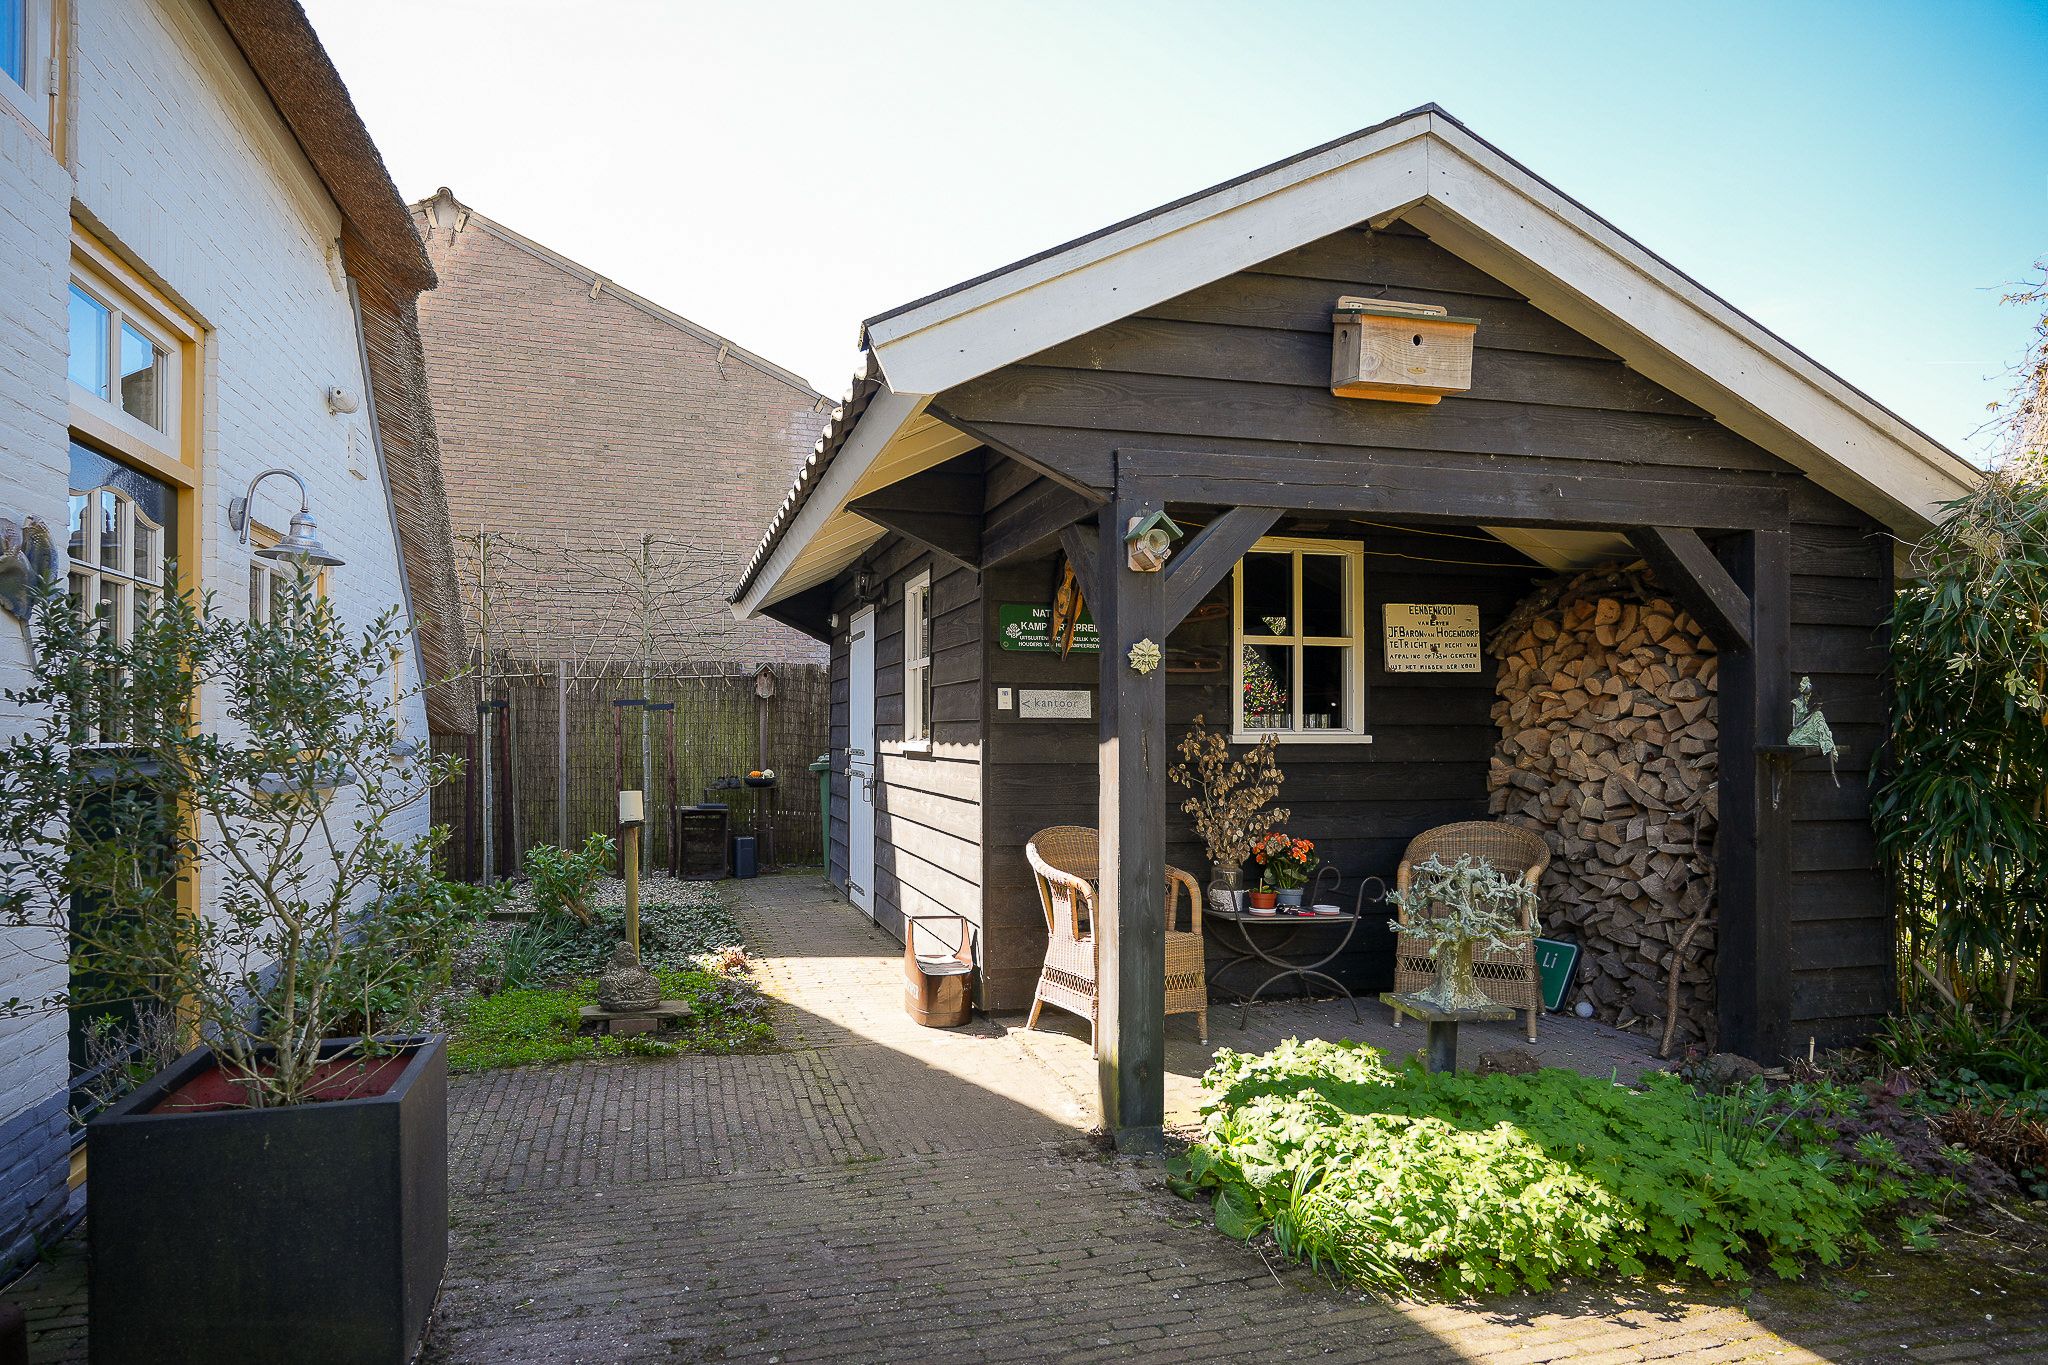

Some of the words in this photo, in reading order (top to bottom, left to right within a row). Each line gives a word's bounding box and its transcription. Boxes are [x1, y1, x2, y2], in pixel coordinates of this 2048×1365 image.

[1409, 606, 1456, 615] EENDENKOOI
[1020, 622, 1098, 632] KAMPRERREI
[1035, 698, 1077, 707] kantoor
[1542, 952, 1558, 969] Li
